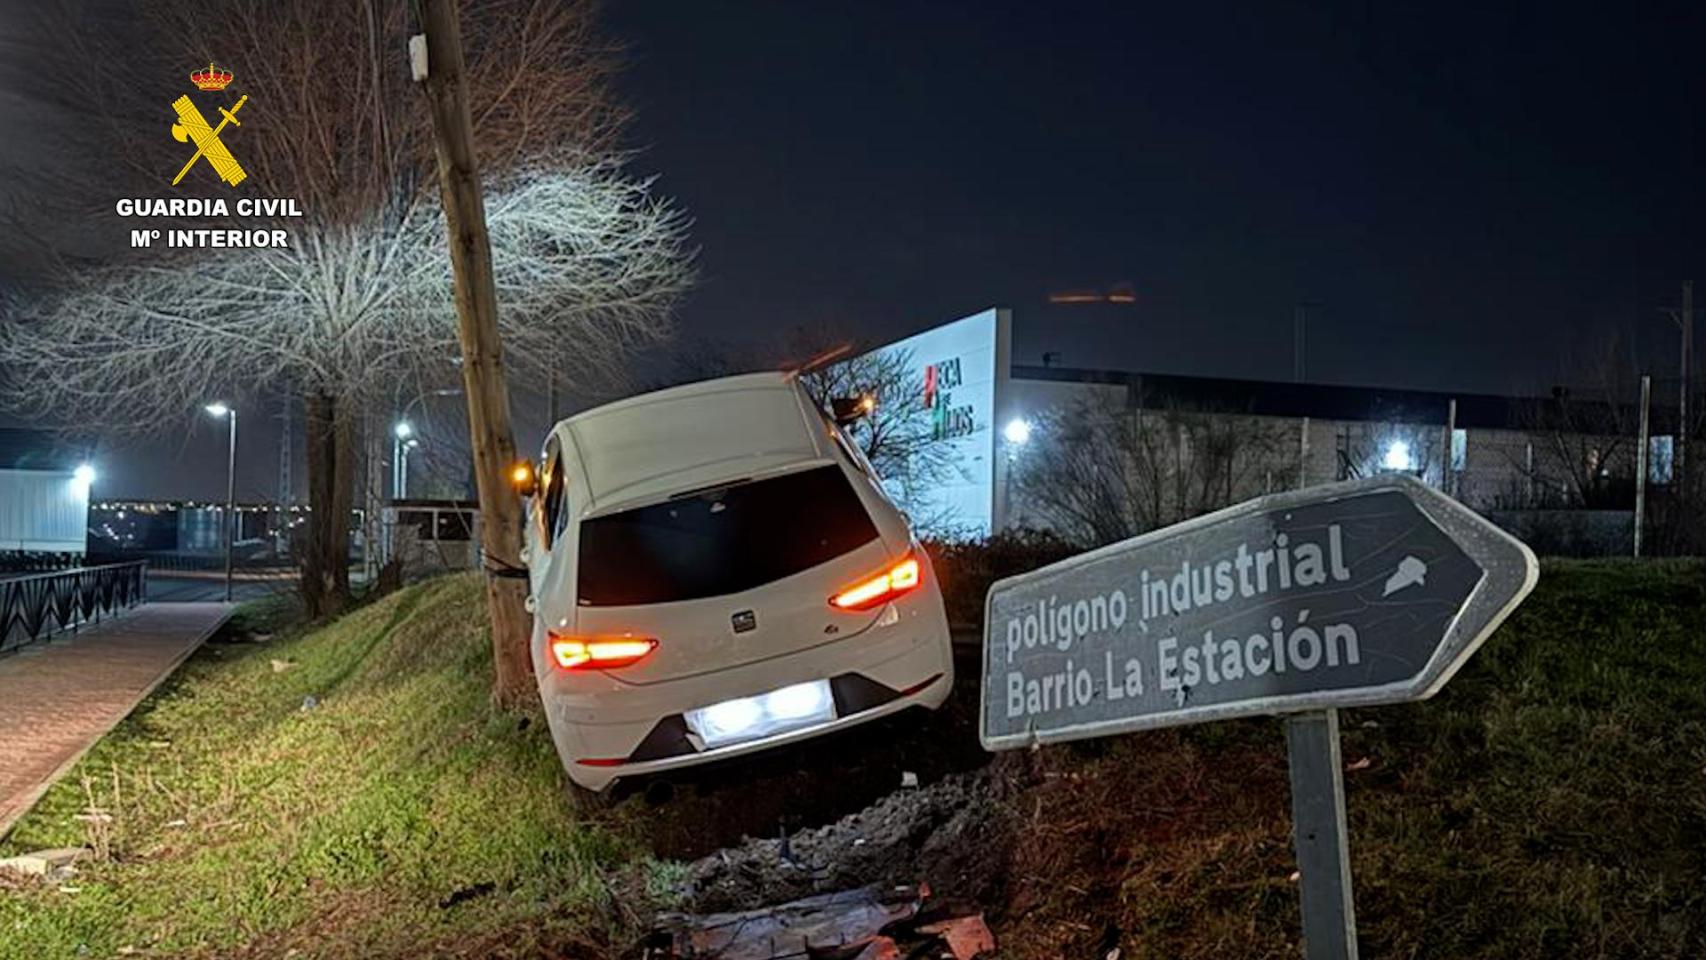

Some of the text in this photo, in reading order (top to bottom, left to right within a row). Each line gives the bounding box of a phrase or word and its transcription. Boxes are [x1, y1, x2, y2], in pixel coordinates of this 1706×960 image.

[1006, 523, 1350, 664] polígono industrial
[1006, 608, 1360, 718] Barrio La Estación
